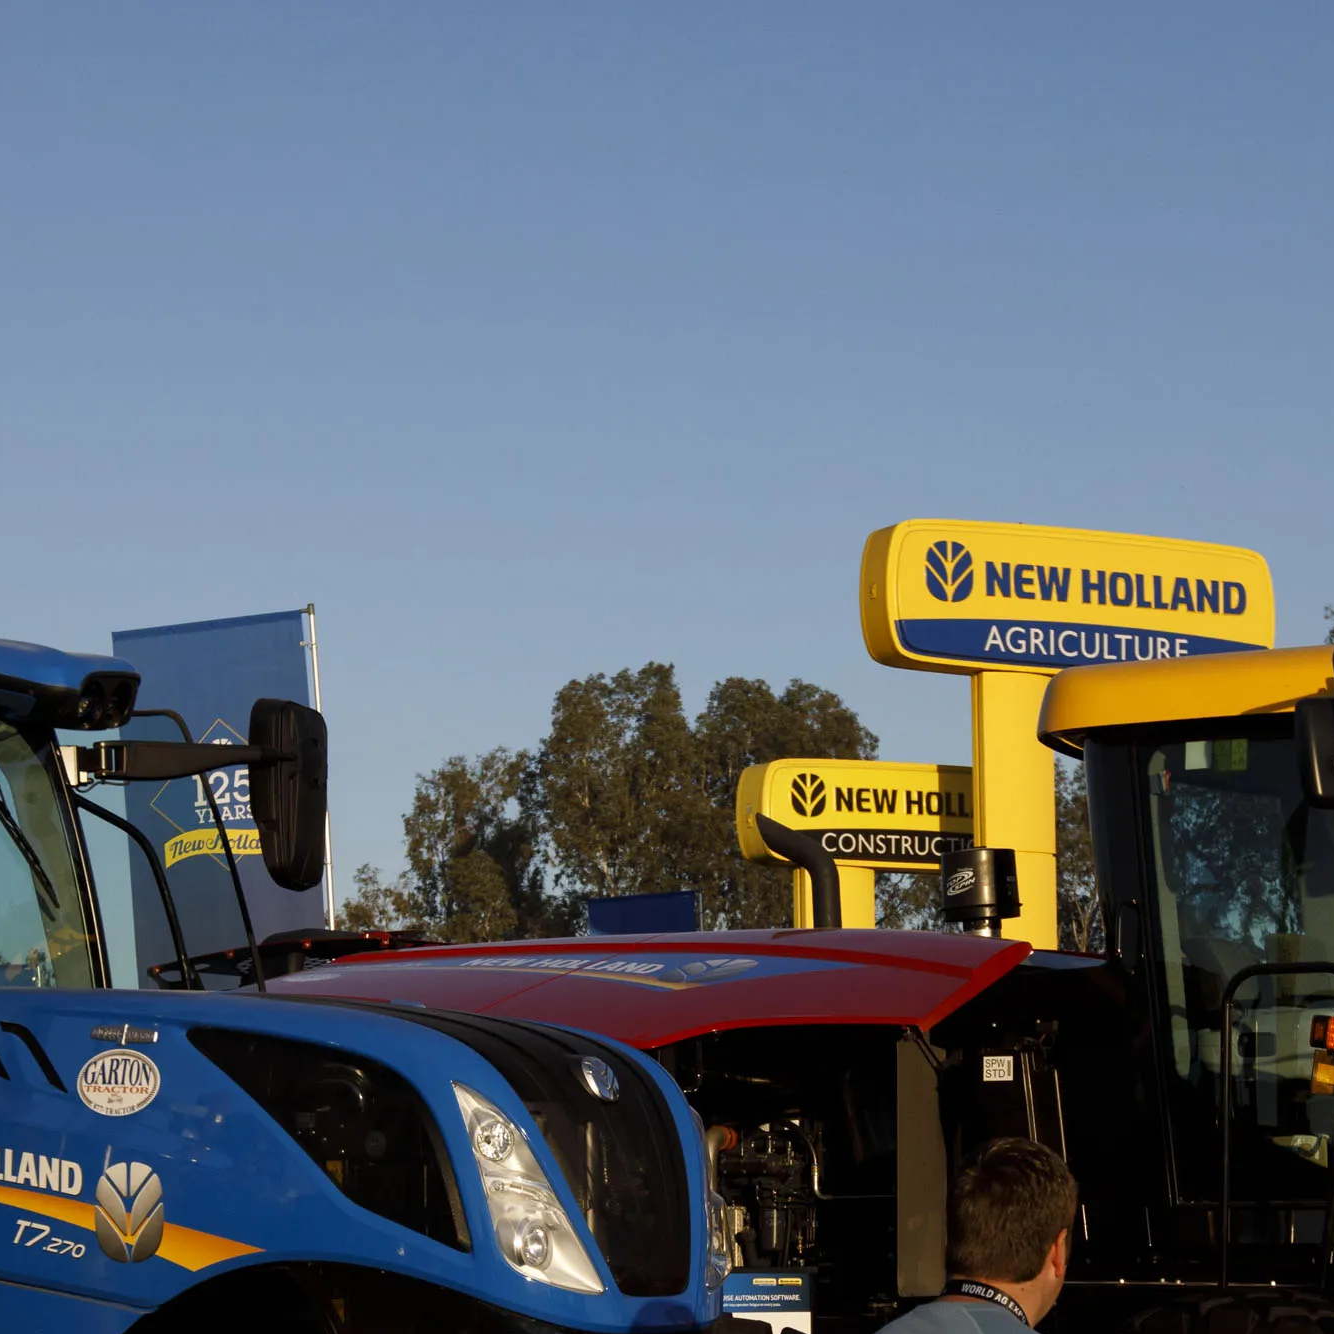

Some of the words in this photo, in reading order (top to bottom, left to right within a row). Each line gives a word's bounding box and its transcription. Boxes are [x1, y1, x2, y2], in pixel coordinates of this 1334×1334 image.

[985, 561, 1071, 602] NEW
[1081, 568, 1247, 616] HOLLAND
[984, 624, 1189, 661] AGRICULTURE
[191, 769, 250, 807] 125
[835, 787, 897, 813] NEW
[905, 790, 973, 818] HOLL
[169, 836, 205, 859] New
[205, 833, 262, 851] Holla
[461, 957, 531, 967] NEW
[530, 958, 665, 974] HOLLAND
[84, 1058, 152, 1087] GARTON
[985, 1058, 1005, 1068] SPW
[985, 1068, 1006, 1078] STD
[83, 1085, 149, 1094] TRACTOR
[13, 1219, 86, 1259] T7.270
[961, 1282, 995, 1299] WORLD
[994, 1293, 1009, 1305] AG
